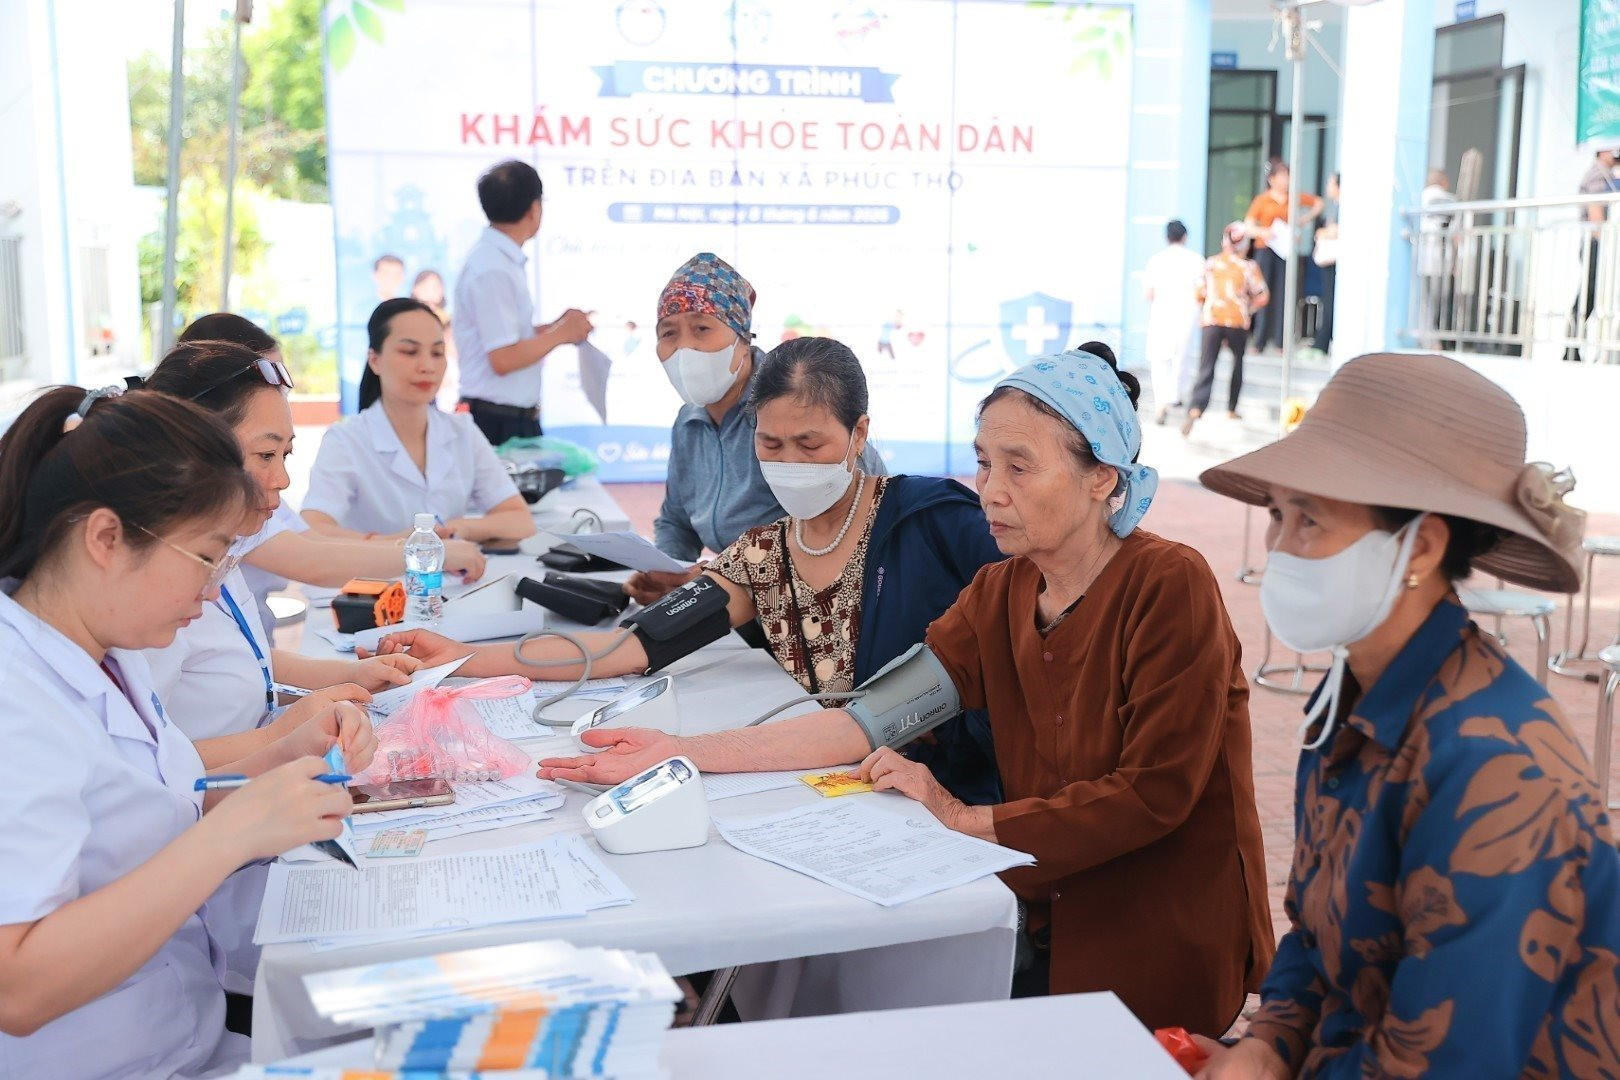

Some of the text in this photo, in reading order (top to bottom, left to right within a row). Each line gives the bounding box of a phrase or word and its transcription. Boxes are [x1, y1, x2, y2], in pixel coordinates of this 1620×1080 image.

[642, 65, 862, 96] CHƯƠNG TRÌNH
[459, 104, 592, 147] KHÁM
[609, 107, 692, 148] SỨC
[836, 113, 941, 152] TOÀN
